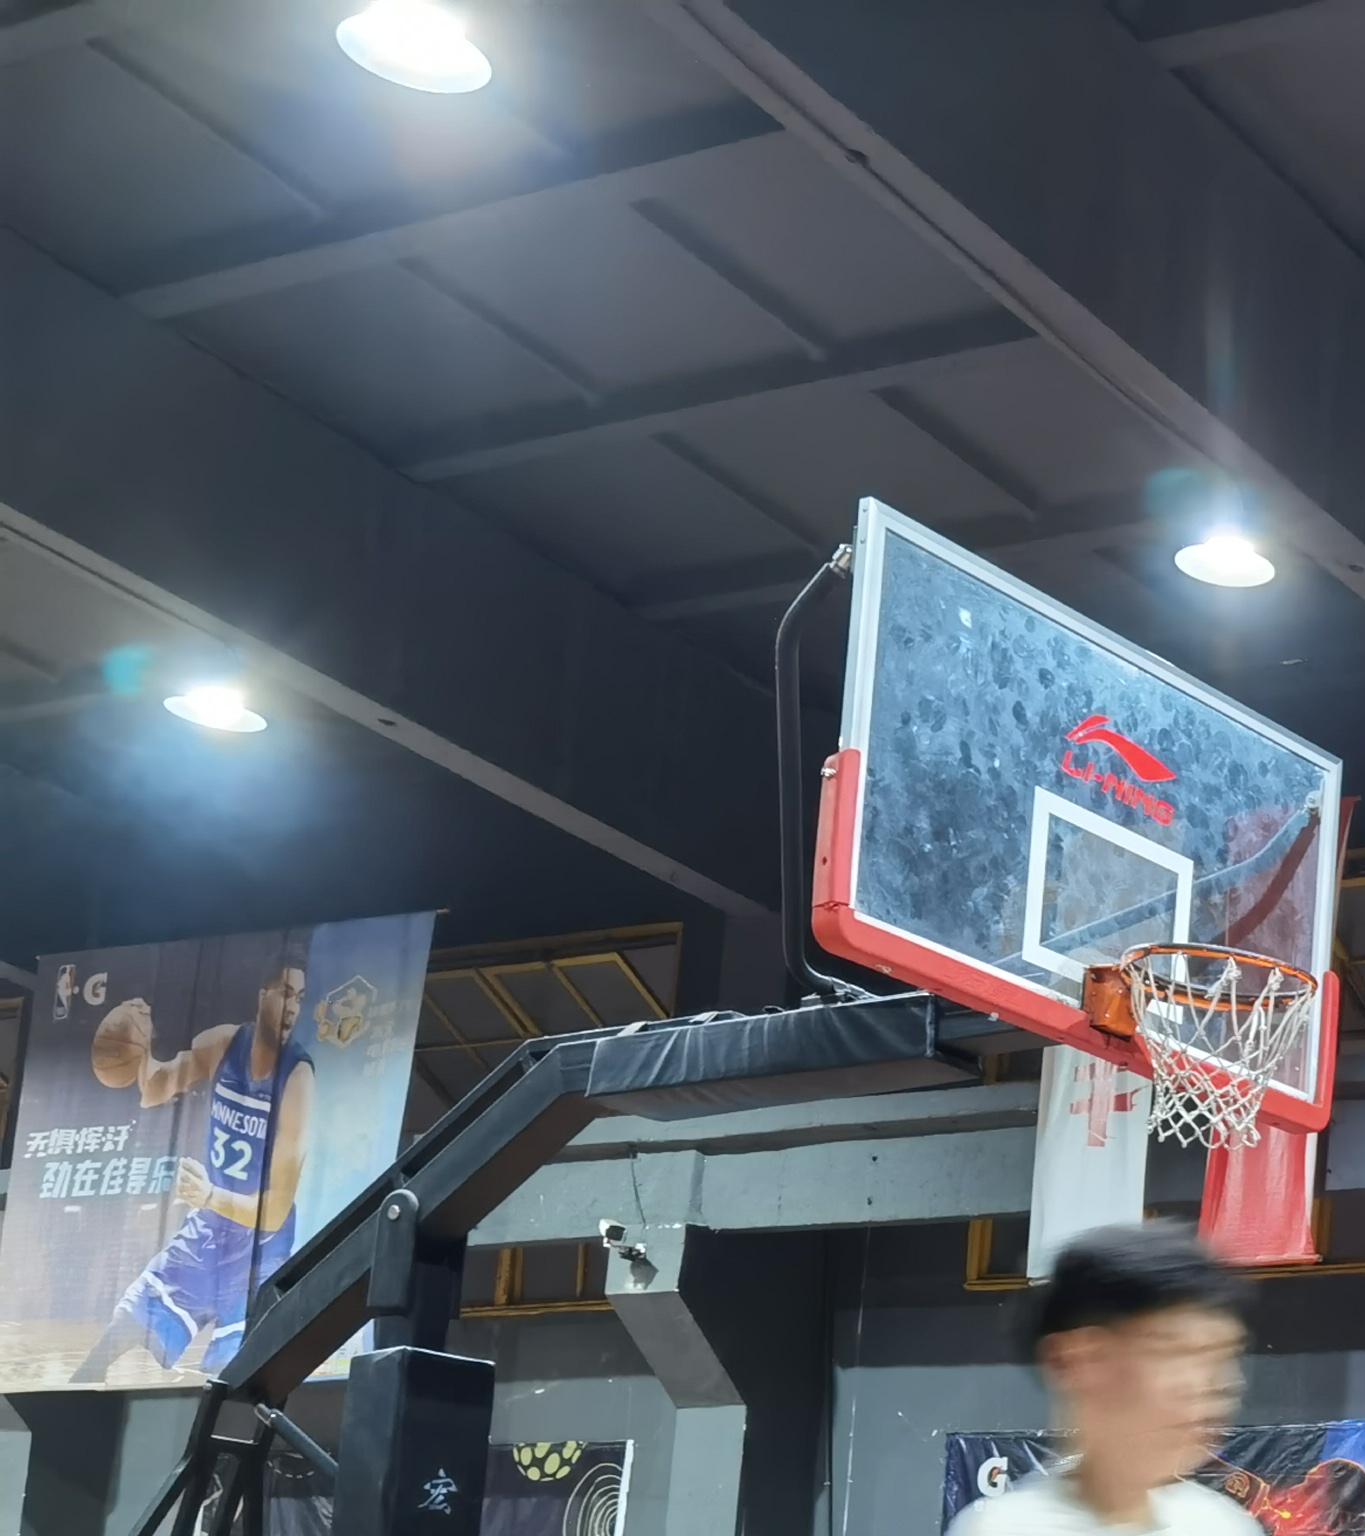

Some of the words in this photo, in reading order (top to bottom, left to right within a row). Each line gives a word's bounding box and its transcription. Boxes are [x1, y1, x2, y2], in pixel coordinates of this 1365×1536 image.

[1061, 751, 1176, 826] LI-NING
[211, 1127, 252, 1180] 32
[977, 1456, 1008, 1497] G
